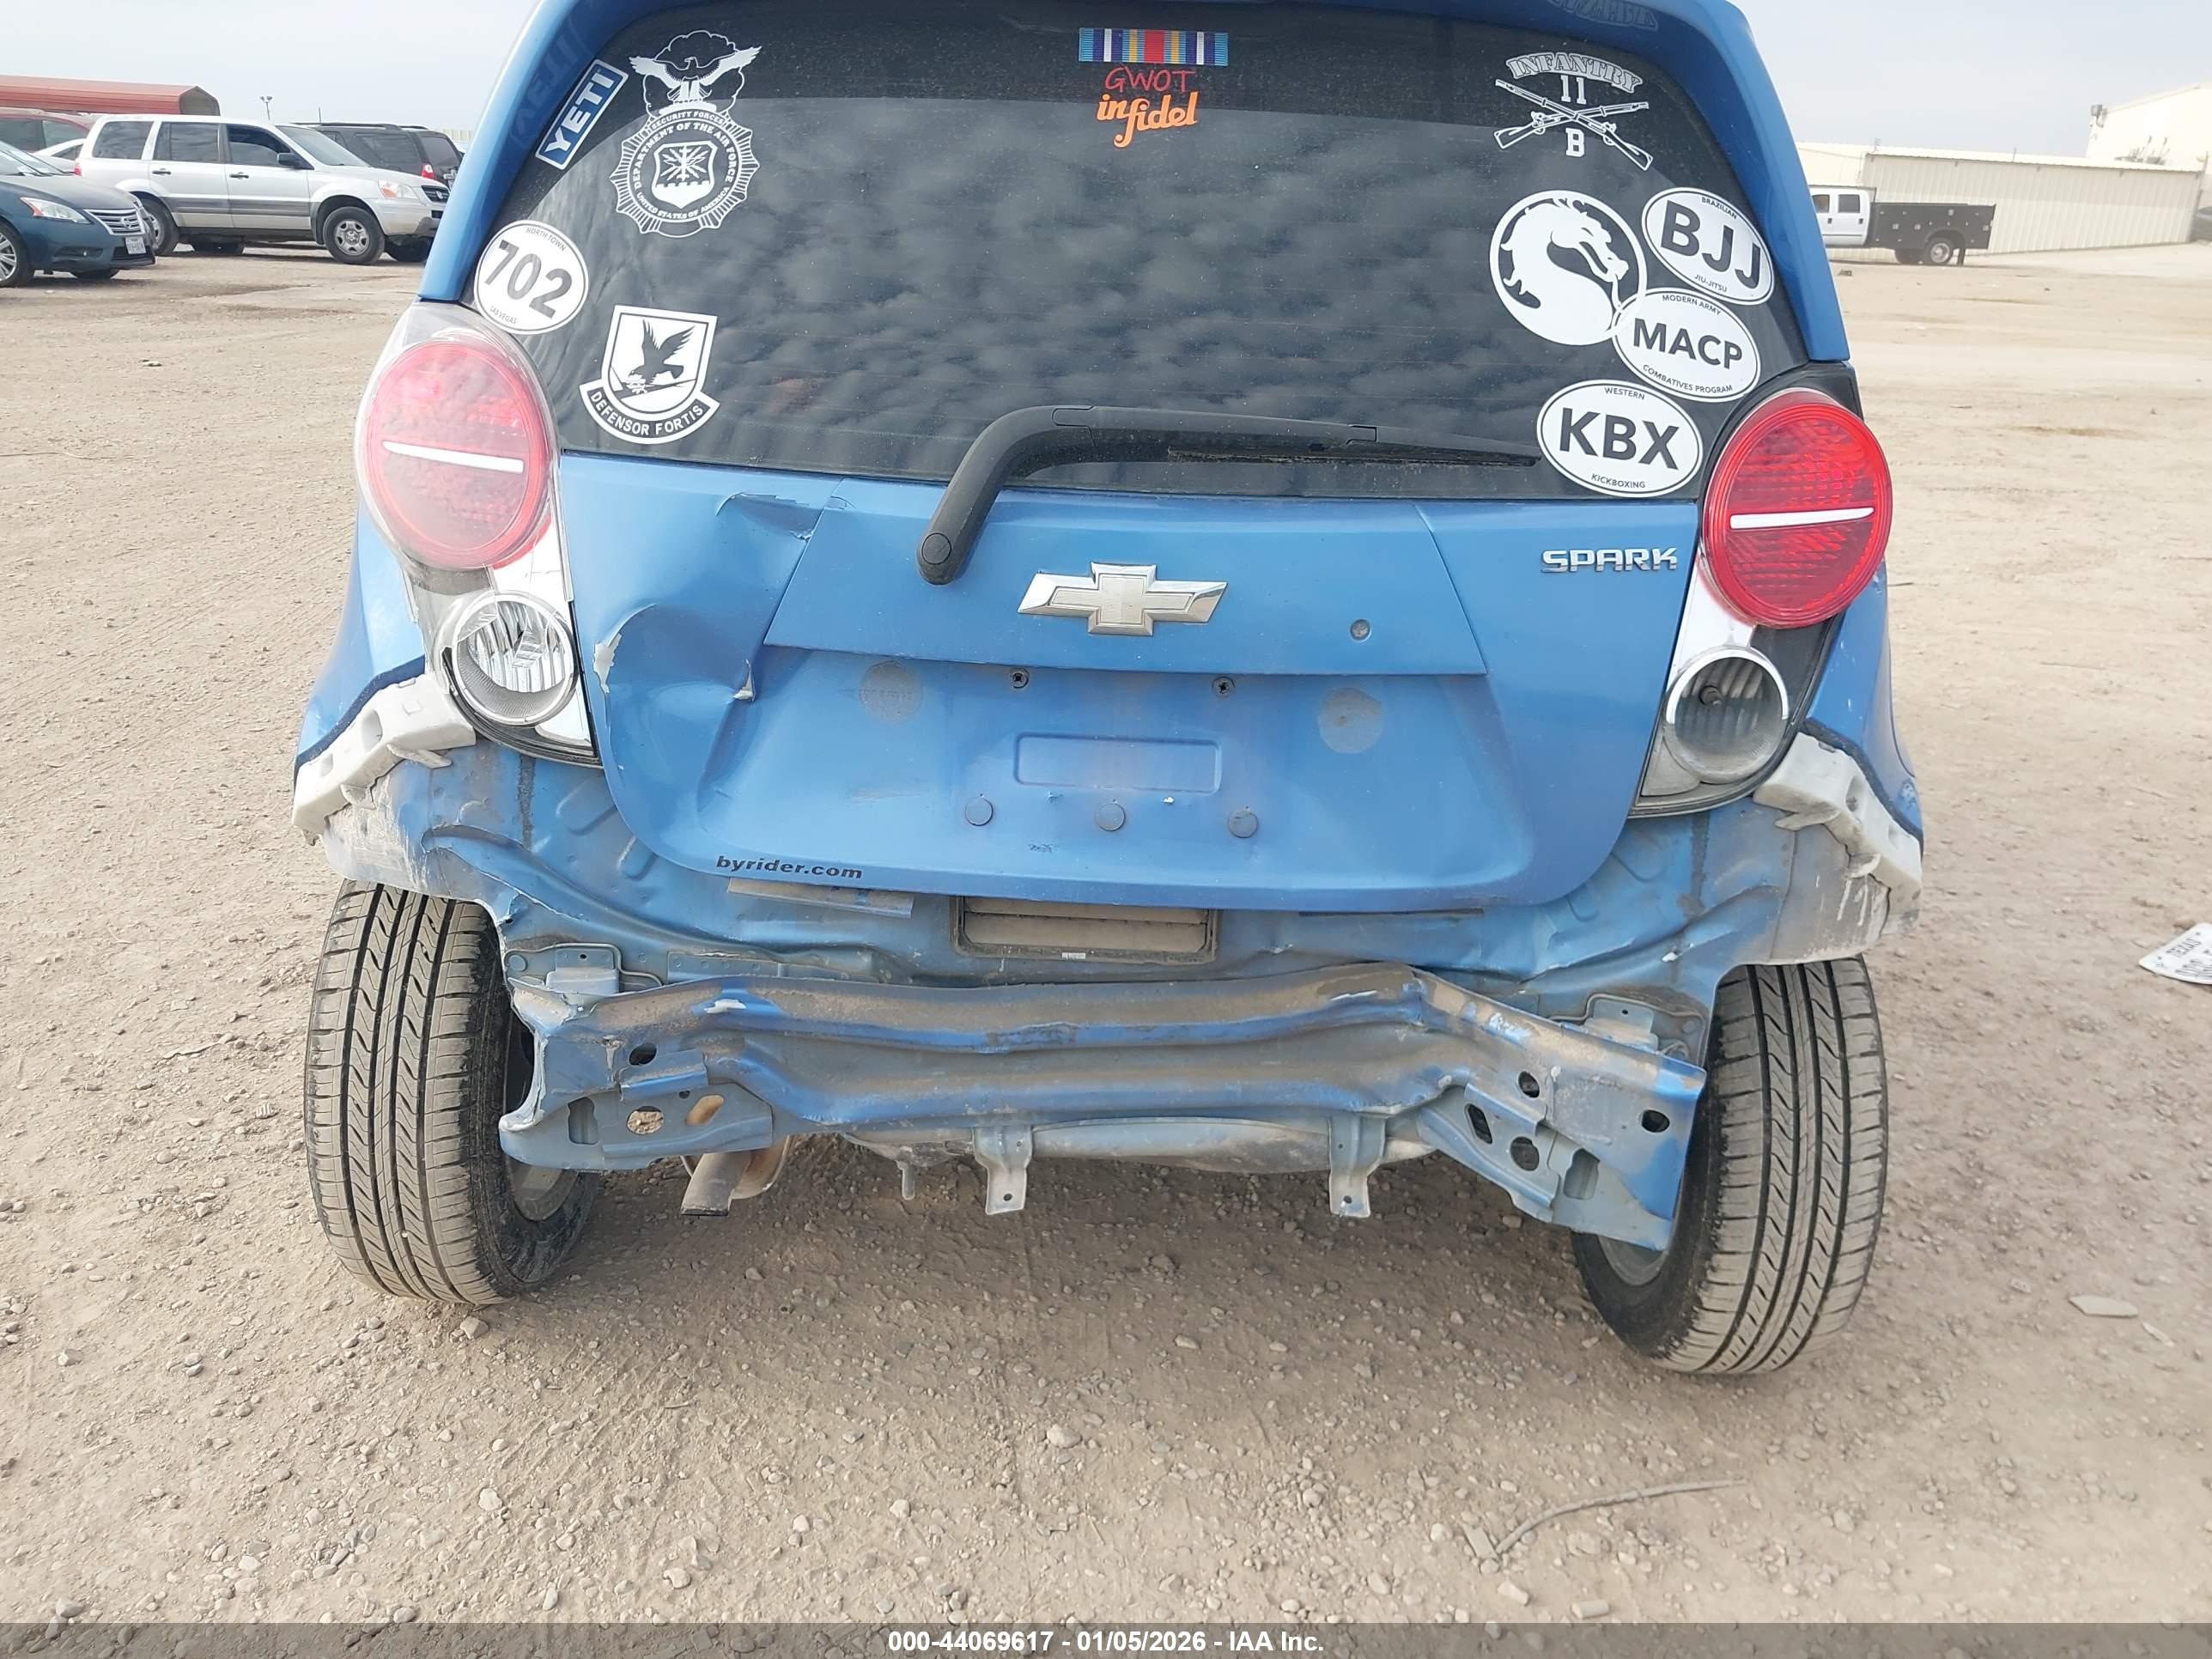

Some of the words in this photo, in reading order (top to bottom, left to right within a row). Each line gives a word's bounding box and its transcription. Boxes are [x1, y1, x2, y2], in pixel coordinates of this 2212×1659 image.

[1104, 66, 1195, 93] GWOT
[1506, 52, 1643, 94] INFANTRY
[1560, 75, 1587, 105] 11
[544, 72, 615, 153] YETI
[652, 111, 691, 130] SECURITY
[693, 111, 725, 125] FORCES
[1097, 91, 1199, 148] infidel
[633, 125, 674, 189] DEPARTMENT
[677, 122, 691, 131] OF
[693, 122, 714, 133] THE
[714, 131, 731, 149] AIR
[725, 146, 738, 183] FORCE
[1565, 128, 1585, 157] B
[637, 191, 659, 214] UNITED
[658, 210, 688, 219] STATES
[688, 209, 699, 217] OF
[701, 186, 730, 213] AMERICA
[1701, 197, 1737, 220] BRAZILIAN
[526, 227, 548, 239] NORTH
[548, 235, 566, 252] TOWN
[1661, 200, 1760, 289] BJJ
[484, 240, 572, 319] 702
[1694, 274, 1728, 293] JIU-JITSU
[490, 306, 500, 315] LAS
[499, 311, 517, 324] VEGAS
[1662, 295, 1698, 306] MODERN
[1698, 301, 1721, 315] ARMY
[1633, 318, 1742, 369] MACP
[1643, 364, 1692, 392] COMBATIVES
[1695, 385, 1733, 393] PROGRAM
[1604, 387, 1645, 400] WESTERN
[591, 391, 649, 435] DEFENSOR
[655, 404, 703, 434] FORTIS
[1559, 407, 1680, 471] KBX
[1591, 473, 1646, 489] KICKBOXING
[1542, 548, 1678, 573] SPARK
[716, 855, 863, 879] byrider.com
